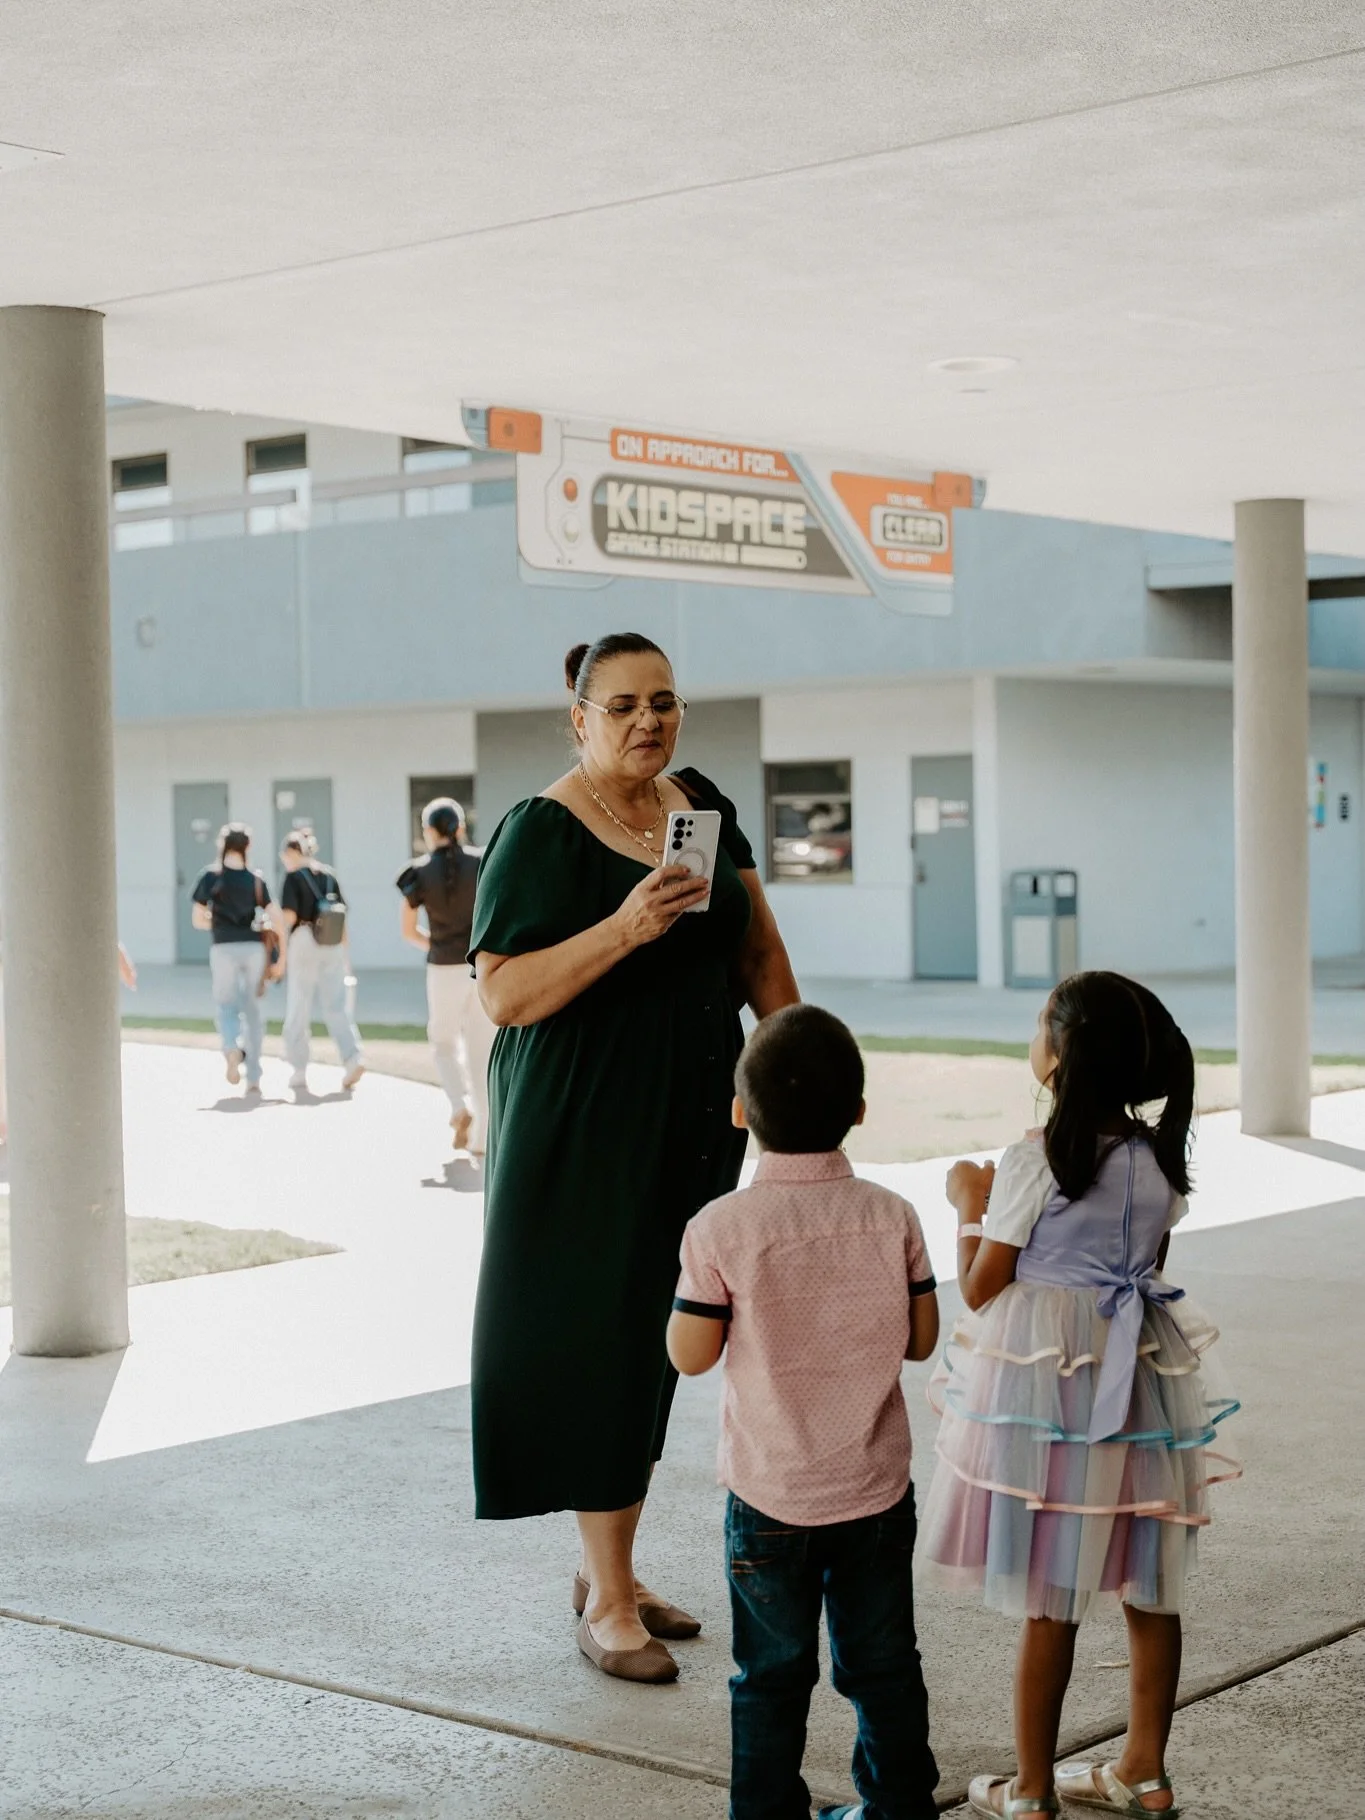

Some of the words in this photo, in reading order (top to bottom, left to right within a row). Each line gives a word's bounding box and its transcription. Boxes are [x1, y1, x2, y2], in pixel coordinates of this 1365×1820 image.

[616, 434, 643, 459] ON
[647, 438, 739, 472] APPROACH
[606, 480, 808, 548] KIDSPACE
[883, 514, 942, 546] CLEAR
[605, 531, 658, 558] SPACE
